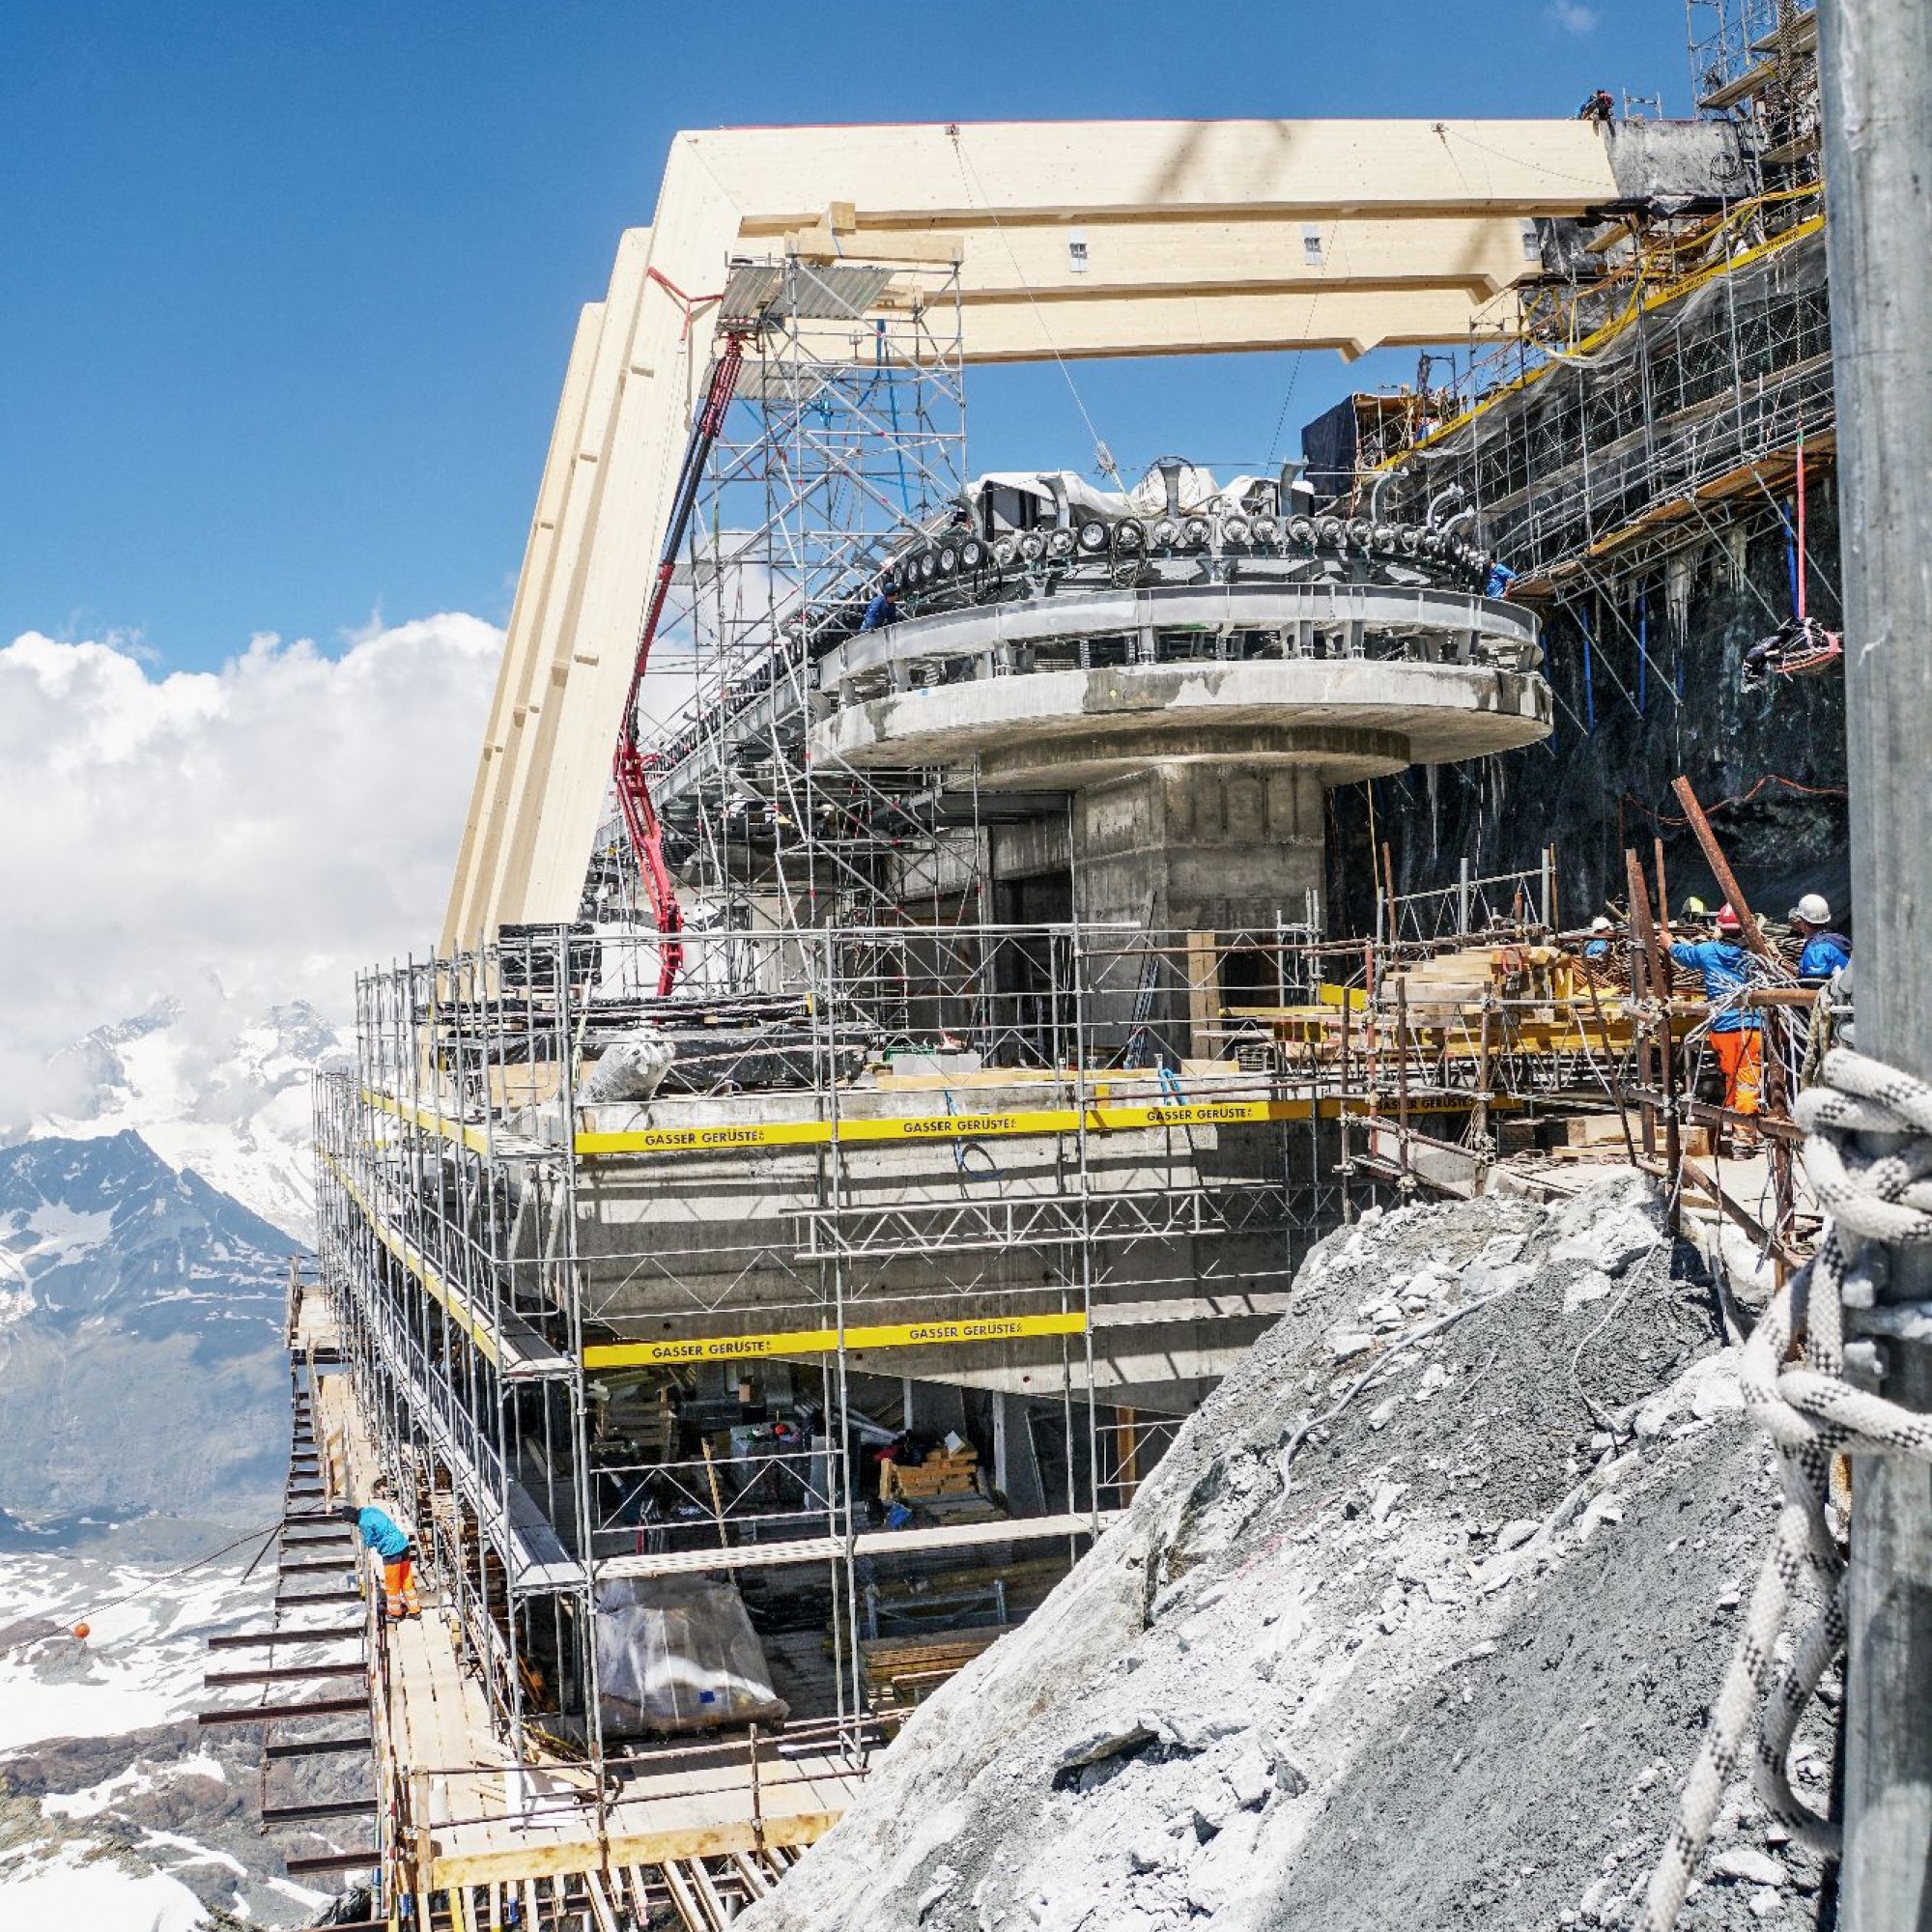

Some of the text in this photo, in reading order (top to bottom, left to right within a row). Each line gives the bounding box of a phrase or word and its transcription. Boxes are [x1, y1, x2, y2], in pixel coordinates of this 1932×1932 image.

[1147, 1109, 1192, 1122] GASSER
[1197, 1105, 1246, 1119] GERÜSTE
[903, 1121, 952, 1133] GASSER
[957, 1118, 1009, 1130] GERÜSTE
[645, 1132, 696, 1146] GASSER
[701, 1128, 757, 1143] GERÜSTE
[909, 1326, 958, 1340] GASSER
[963, 1321, 1015, 1336] GERÜSTE
[651, 1346, 704, 1359] GASSER
[708, 1340, 765, 1354] GERÜSTE
